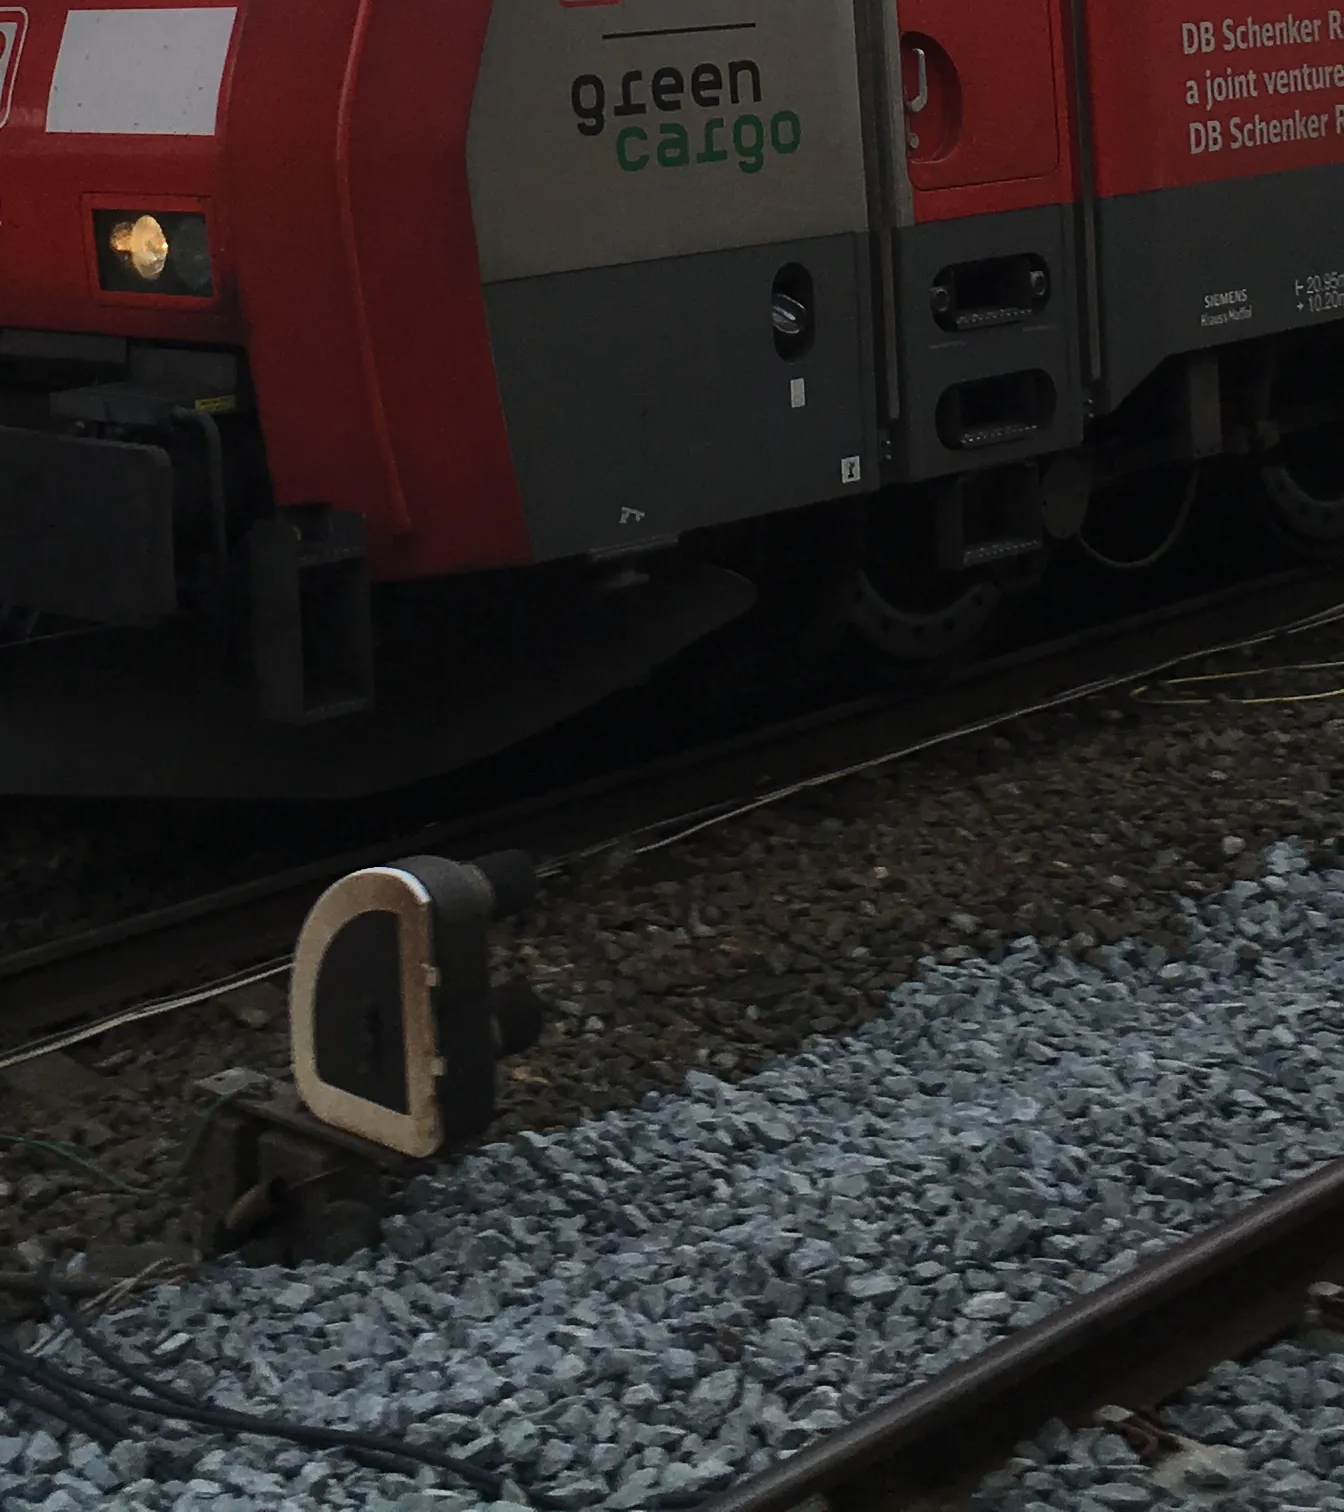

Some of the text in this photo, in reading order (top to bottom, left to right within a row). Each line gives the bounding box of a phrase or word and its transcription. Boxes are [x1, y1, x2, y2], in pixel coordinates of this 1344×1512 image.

[1181, 21, 1216, 55] DB
[1222, 12, 1322, 51] Schenker
[570, 58, 763, 136] green
[1185, 79, 1200, 105] a
[1205, 66, 1258, 111] joint
[616, 110, 801, 173] cargo
[1189, 120, 1223, 155] DB
[1229, 109, 1329, 149] Schenker
[1204, 288, 1248, 309] SIEMENS
